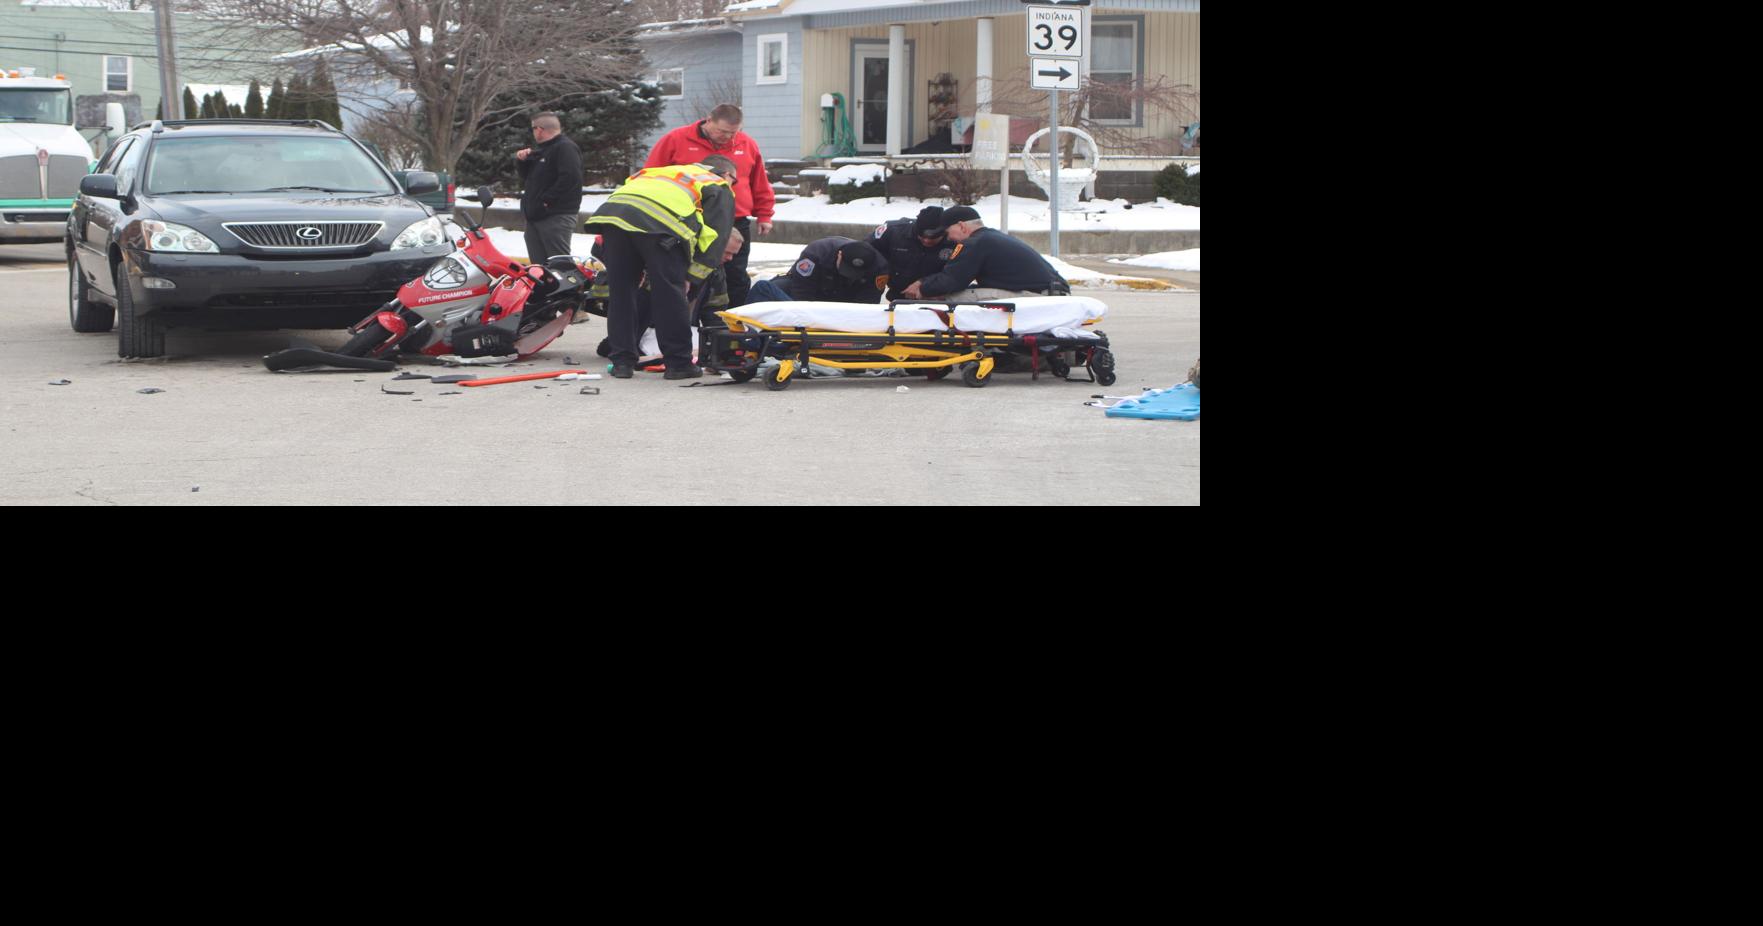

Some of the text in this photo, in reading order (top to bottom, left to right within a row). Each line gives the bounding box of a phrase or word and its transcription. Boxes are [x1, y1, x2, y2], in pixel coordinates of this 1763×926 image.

[1035, 12, 1074, 21] INDIANA
[1034, 24, 1077, 50] 39
[418, 290, 472, 303] FUTURE CHAMPION
